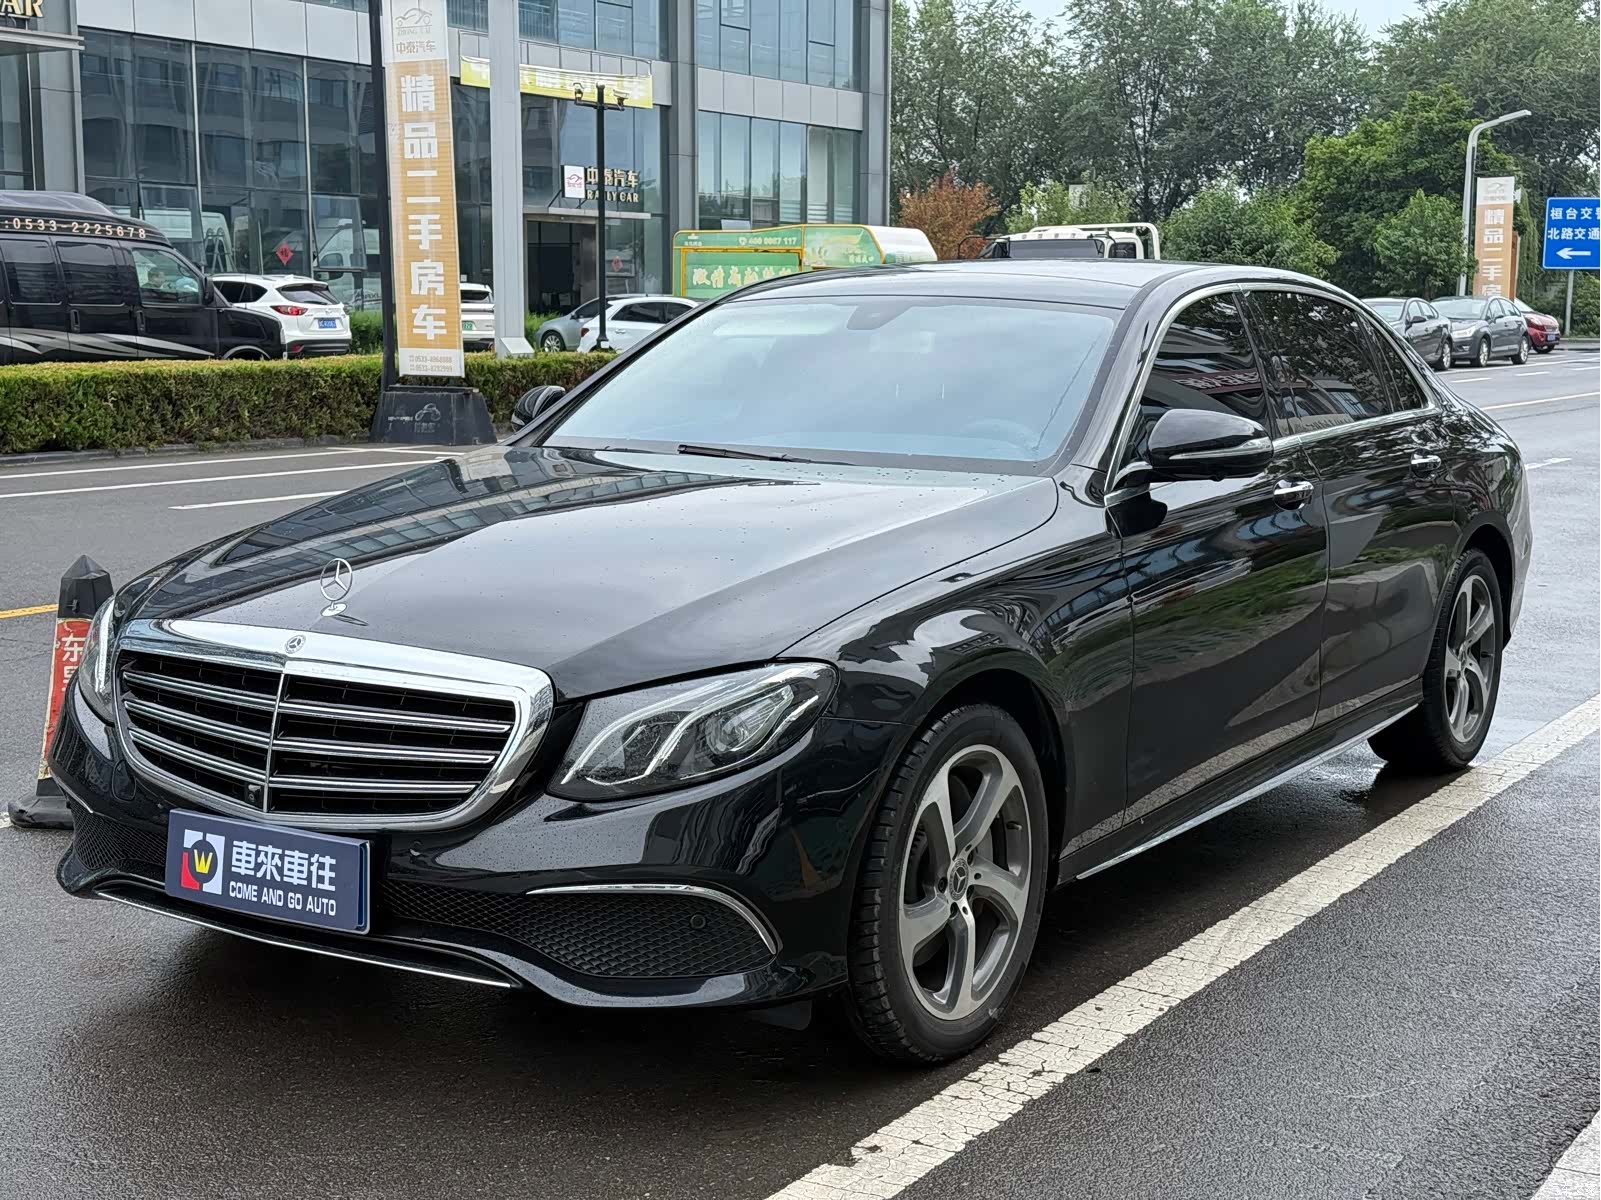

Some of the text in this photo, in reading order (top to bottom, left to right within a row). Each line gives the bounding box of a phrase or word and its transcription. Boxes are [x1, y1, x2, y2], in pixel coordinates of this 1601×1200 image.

[396, 40, 436, 54] 中泰汽车
[401, 74, 447, 340] 精品二手房车
[587, 189, 639, 203] RALY CAR
[1548, 227, 1600, 240] 北路交通
[231, 840, 336, 891] 車來車往
[229, 881, 336, 916] COME AND GO AUTO
